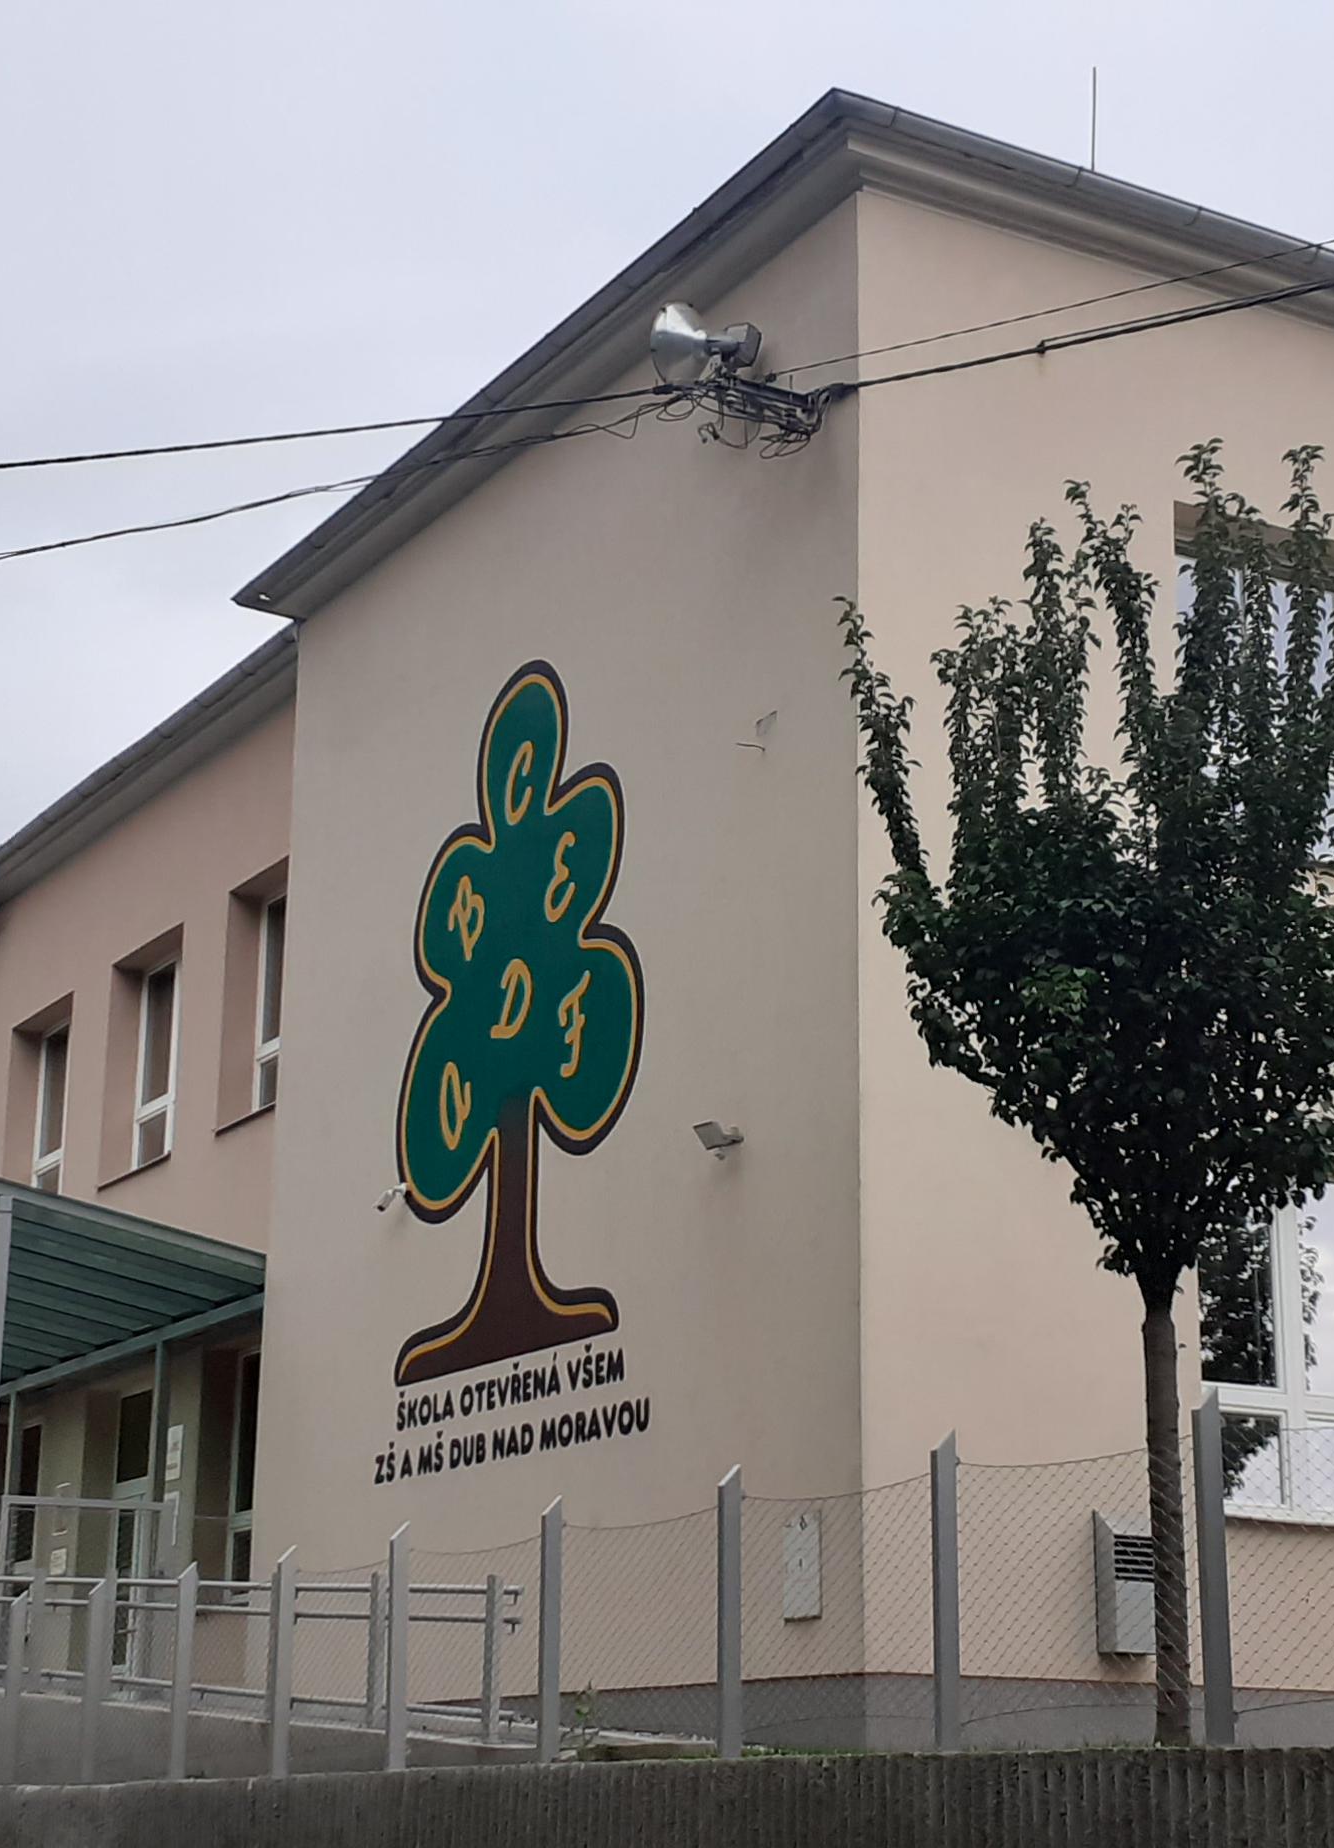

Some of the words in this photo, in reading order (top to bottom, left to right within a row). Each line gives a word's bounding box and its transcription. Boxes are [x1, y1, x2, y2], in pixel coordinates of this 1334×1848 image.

[505, 740, 534, 825] C
[449, 876, 485, 961] B
[545, 831, 576, 922] E
[490, 958, 533, 1039] D
[559, 970, 591, 1077] F
[396, 1391, 455, 1431] ŠKOLA
[460, 1352, 560, 1416] OTEVŘENÁ
[567, 1344, 624, 1391] VŠEM
[374, 1441, 395, 1485] ZŠ
[400, 1449, 413, 1480] A
[417, 1430, 444, 1476] MŠ
[450, 1433, 486, 1470] DUB
[492, 1423, 534, 1461] NAD
[540, 1397, 650, 1451] MORAVOU
